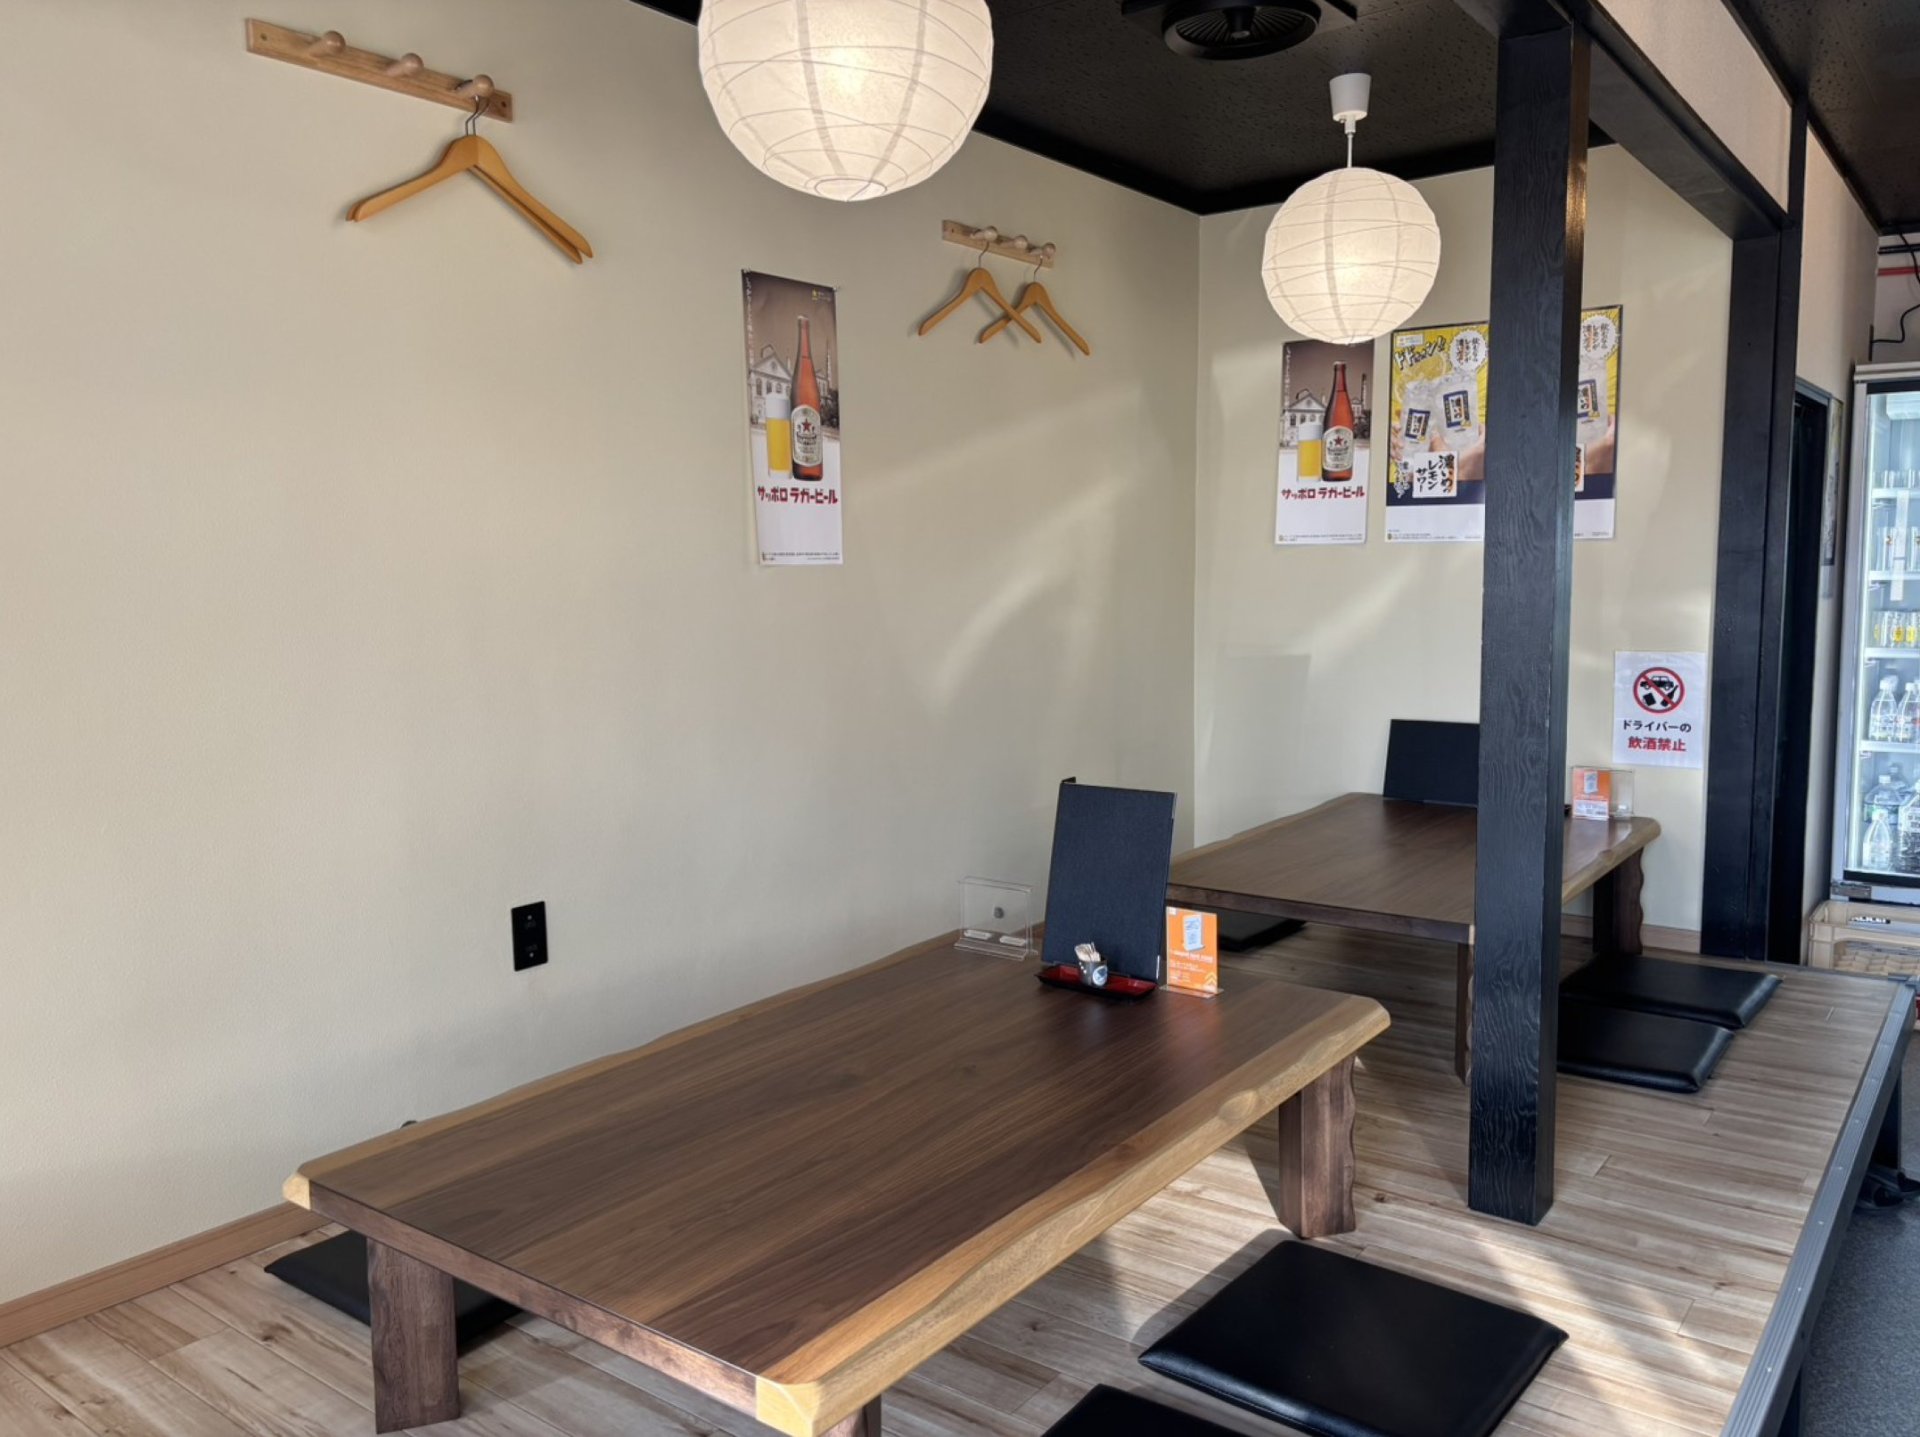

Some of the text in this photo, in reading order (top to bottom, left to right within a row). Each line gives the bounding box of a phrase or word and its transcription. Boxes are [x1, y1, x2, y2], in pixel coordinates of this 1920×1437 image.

[1416, 467, 1428, 493] サワー
[1428, 459, 1439, 491] レモン
[757, 485, 838, 504] サッポロ ラガービール
[1281, 485, 1365, 500] サッポロ ラガービール
[1623, 719, 1692, 733] ドライバーの
[1627, 735, 1687, 752] 飲酒禁止
